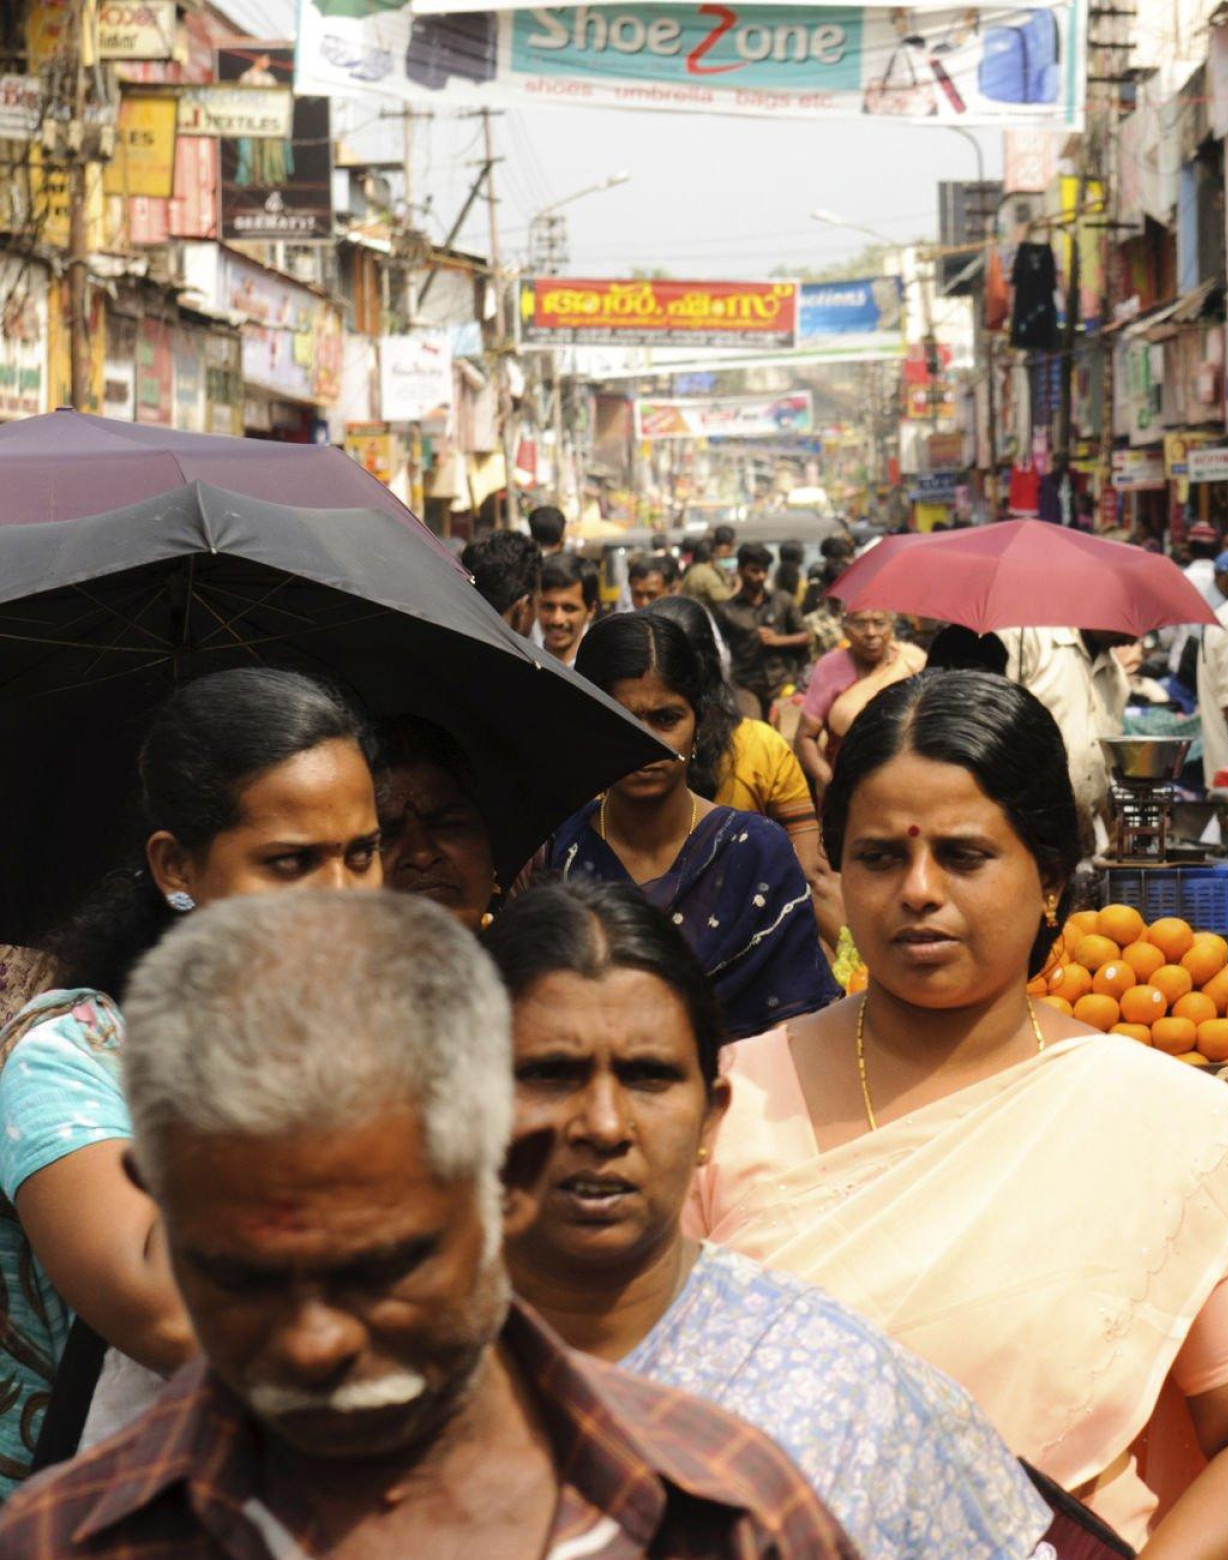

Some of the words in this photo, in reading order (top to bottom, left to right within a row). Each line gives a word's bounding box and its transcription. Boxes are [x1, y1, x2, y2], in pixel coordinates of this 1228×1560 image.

[527, 5, 682, 56] Shoe
[685, 3, 847, 75] Zone
[524, 77, 593, 97] shoes
[614, 83, 715, 104] umbrella
[736, 87, 790, 109] bags
